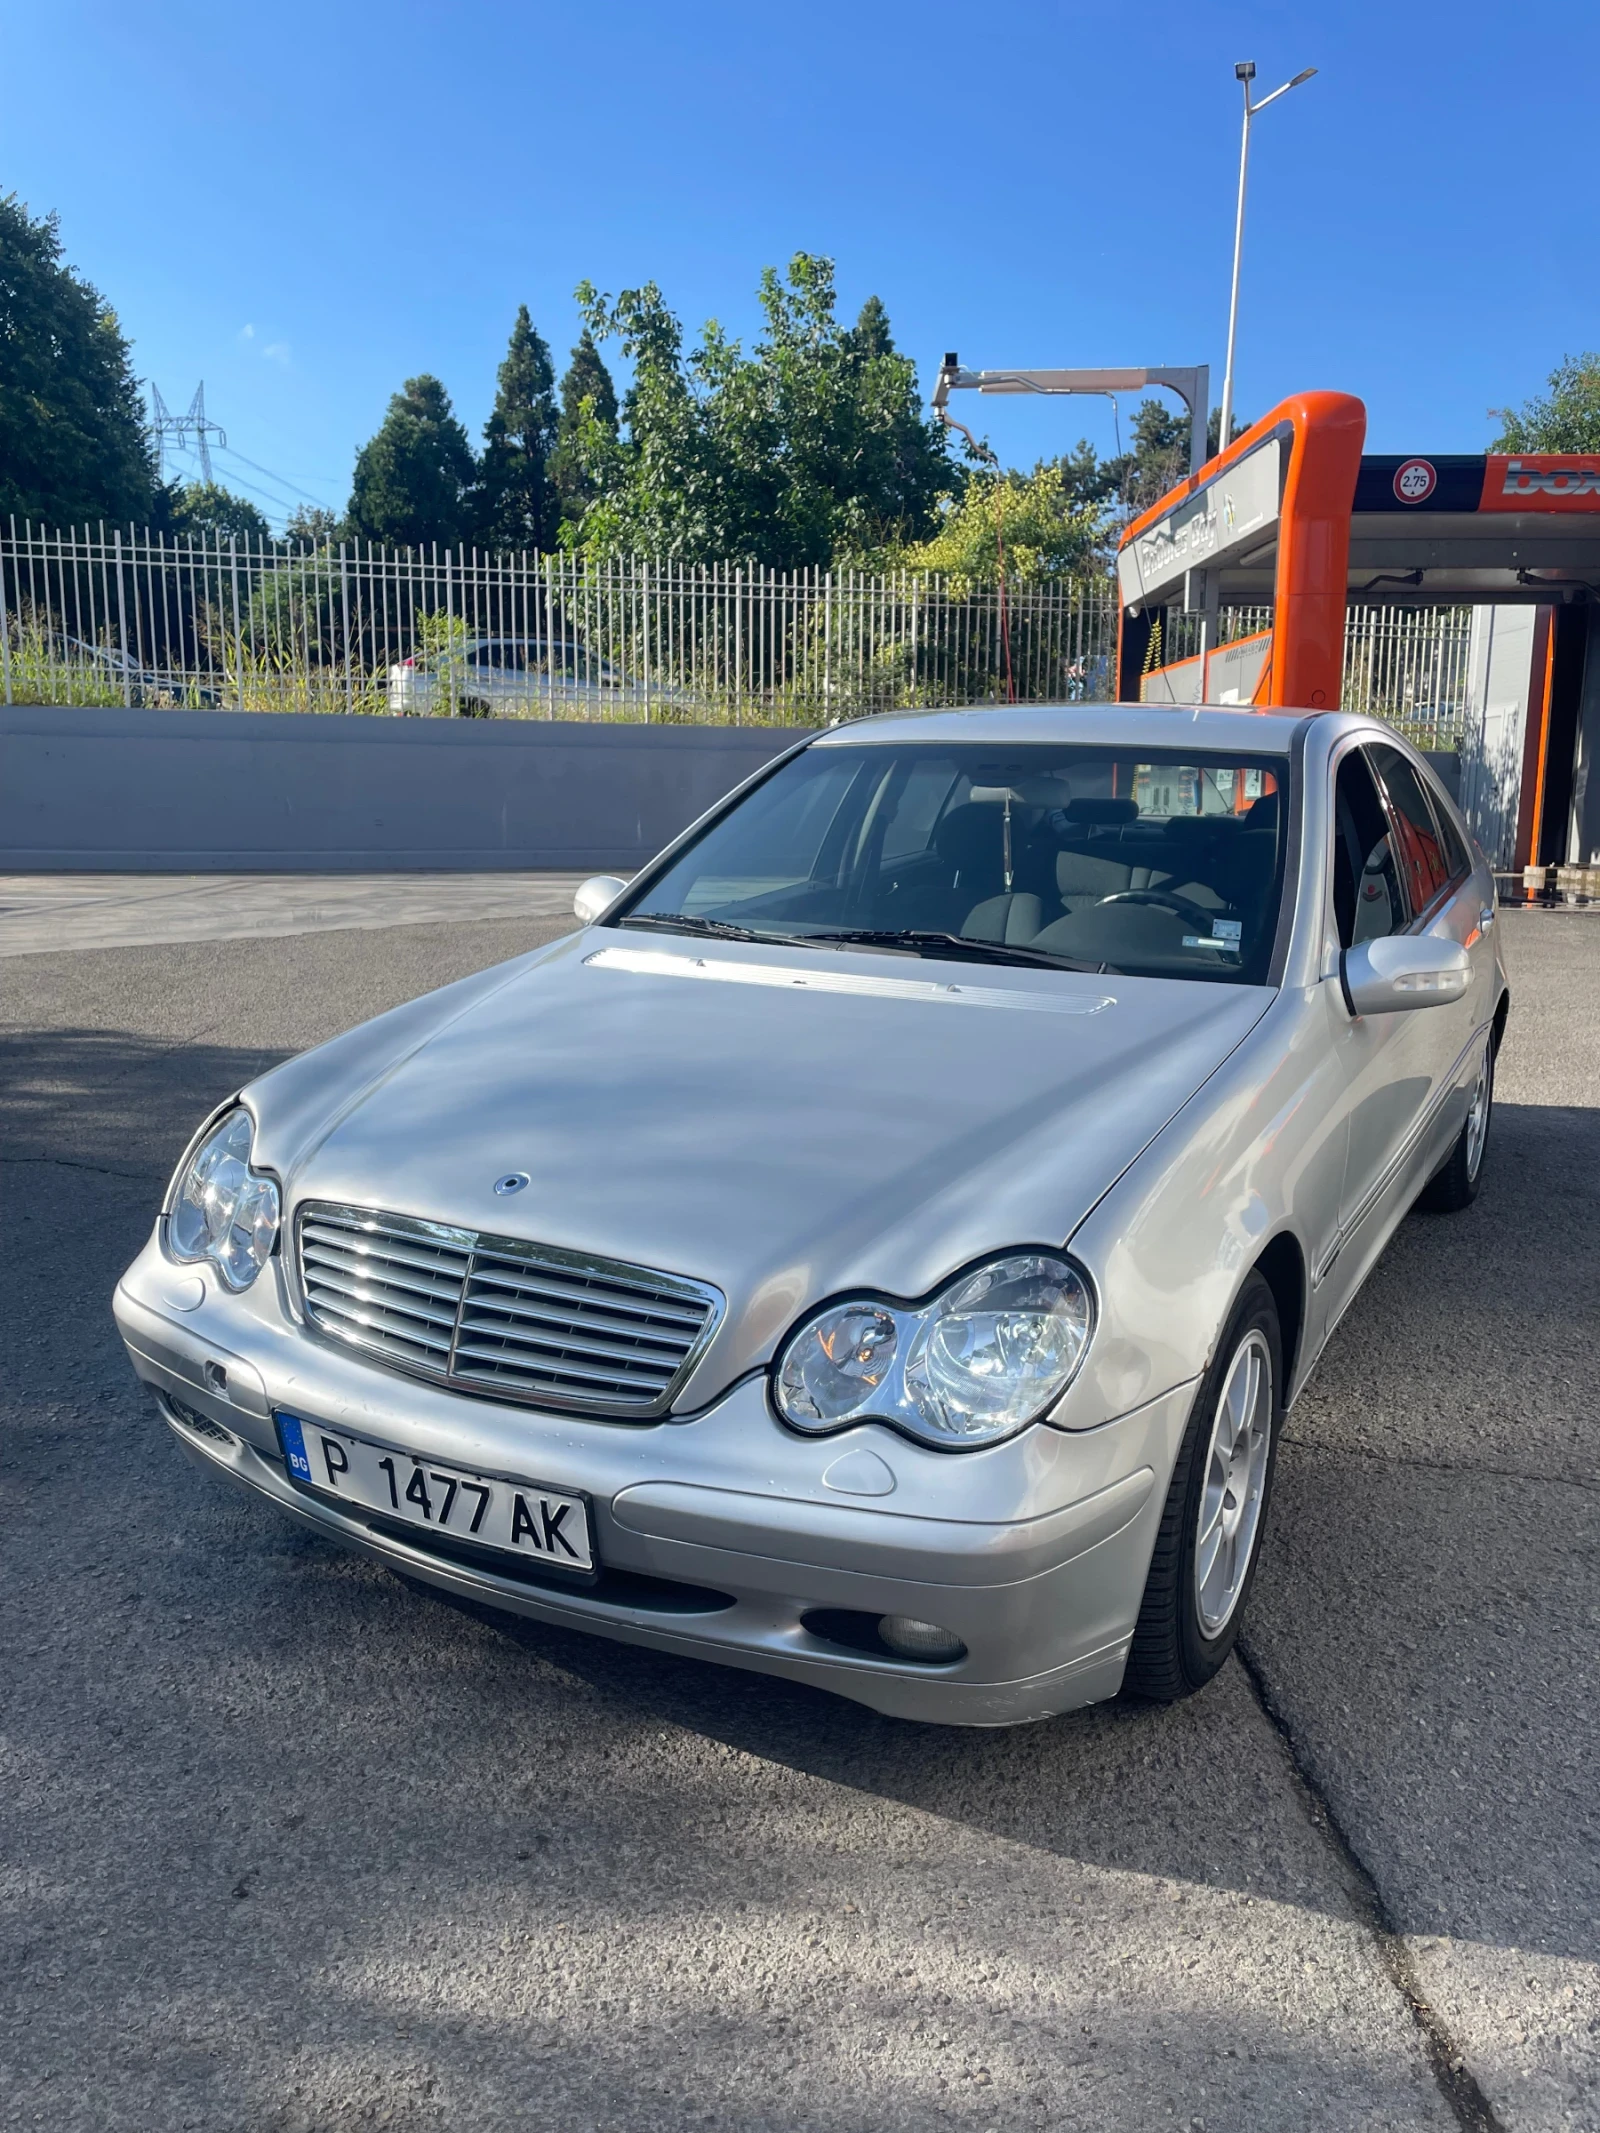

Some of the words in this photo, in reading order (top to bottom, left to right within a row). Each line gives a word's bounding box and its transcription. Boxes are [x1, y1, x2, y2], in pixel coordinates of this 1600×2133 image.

[1402, 475, 1427, 488] 2.75
[289, 1452, 308, 1473] BG
[320, 1434, 350, 1486] P
[377, 1456, 491, 1534] 1477
[510, 1491, 580, 1559] AK
